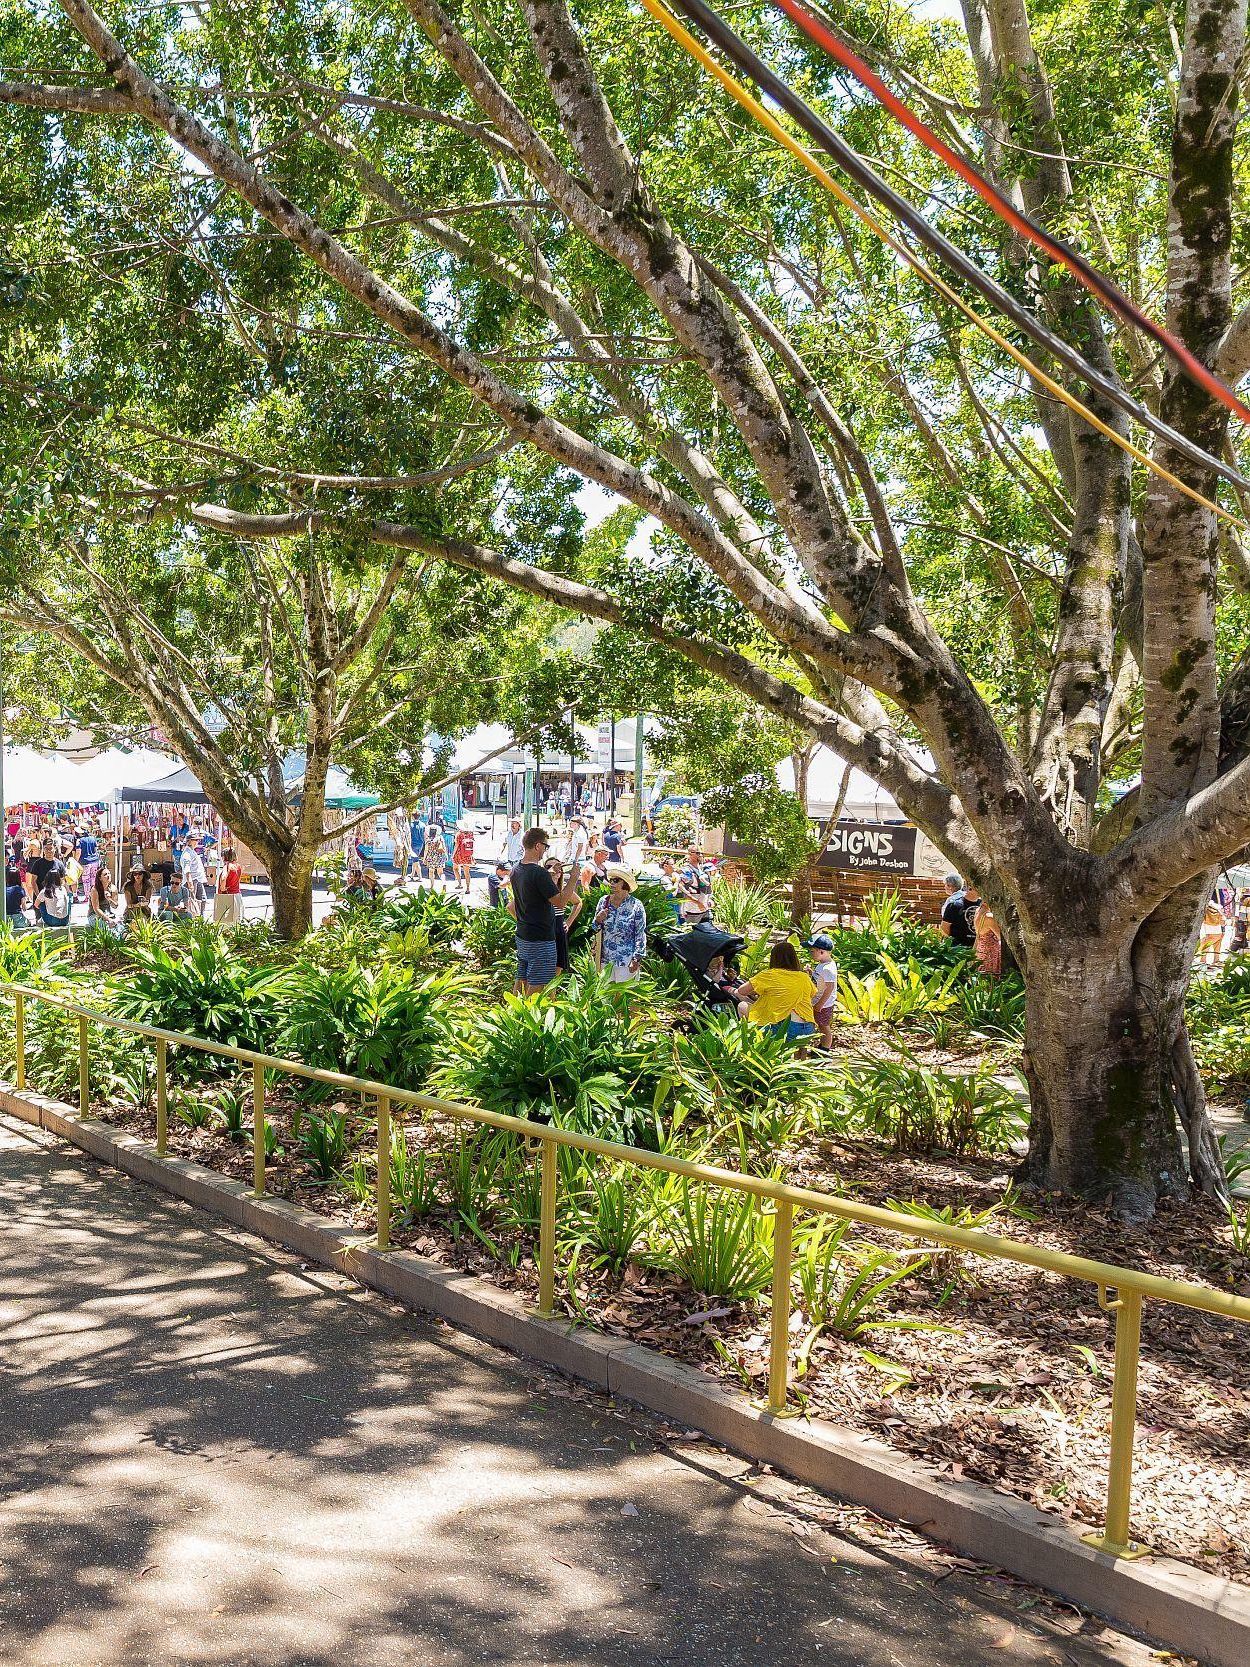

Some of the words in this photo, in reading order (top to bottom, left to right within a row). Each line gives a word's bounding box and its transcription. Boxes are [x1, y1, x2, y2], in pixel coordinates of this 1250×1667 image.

[826, 829, 894, 857] SIGNS
[849, 855, 860, 866] By
[879, 858, 909, 869] Deshon
